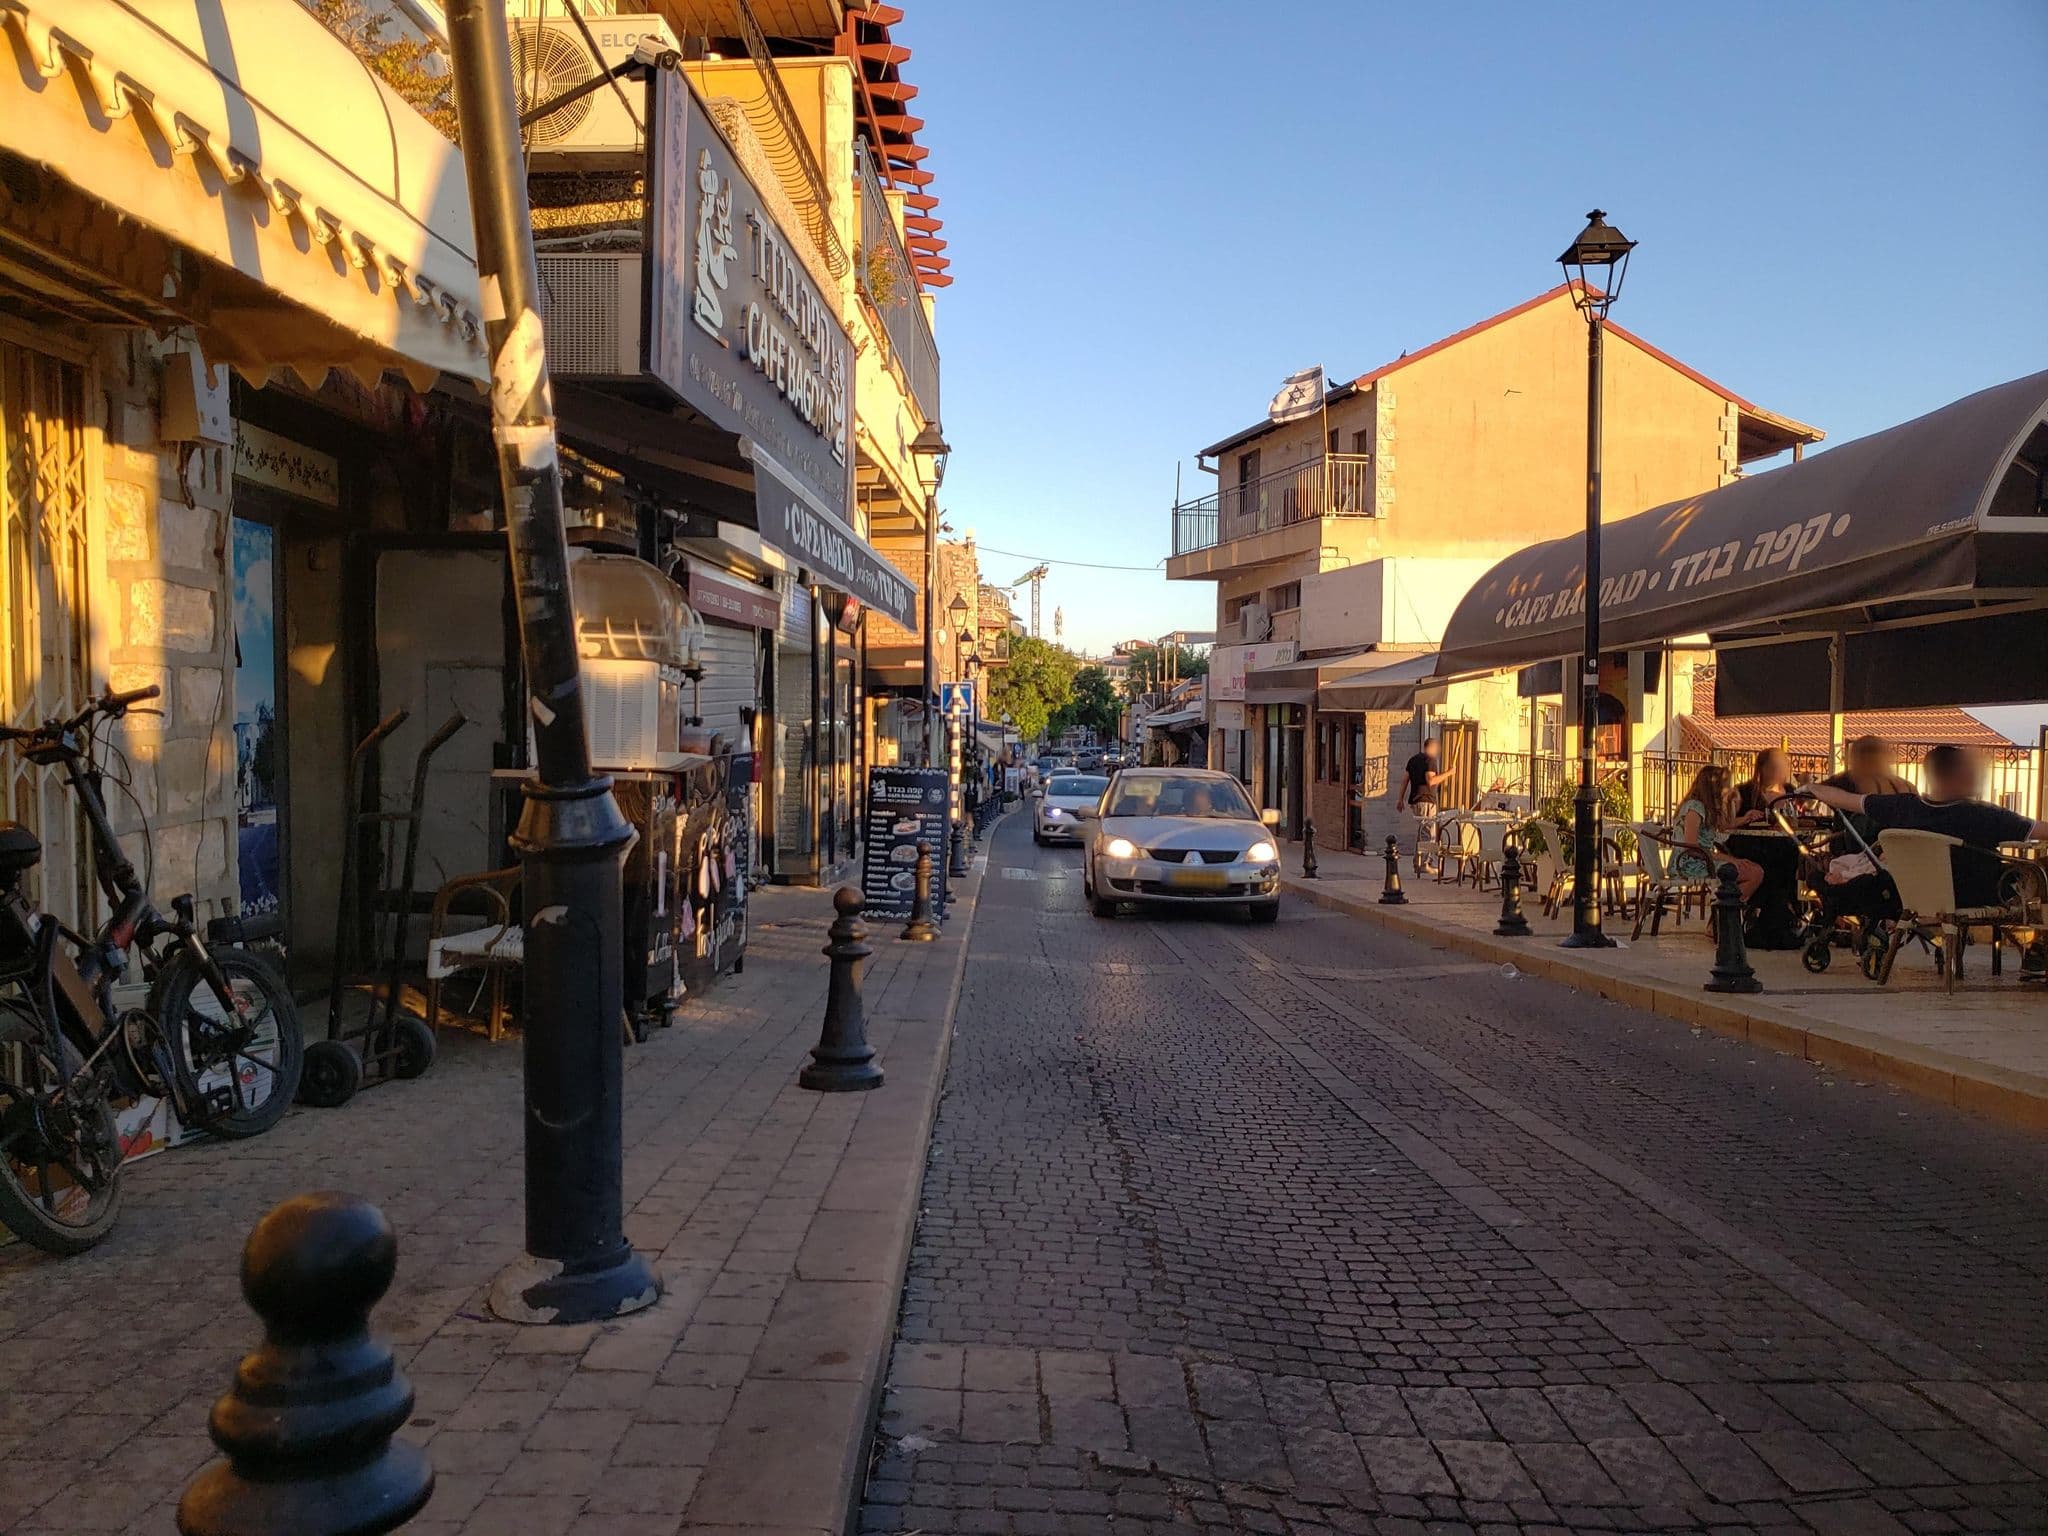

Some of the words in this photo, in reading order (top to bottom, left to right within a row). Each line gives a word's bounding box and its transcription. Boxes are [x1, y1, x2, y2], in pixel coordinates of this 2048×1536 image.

[752, 207, 799, 326] בגדד
[800, 278, 831, 378] קפה
[747, 302, 786, 393] CAFE
[786, 347, 833, 441] BAGDAD
[791, 502, 820, 560] CAFE
[820, 523, 854, 581] BAGDAD
[1666, 541, 1741, 592] בגדד
[1743, 512, 1832, 572] קפה
[1504, 592, 1552, 629] CAFE
[1551, 569, 1647, 619] BADAD
[907, 786, 923, 795] קפה
